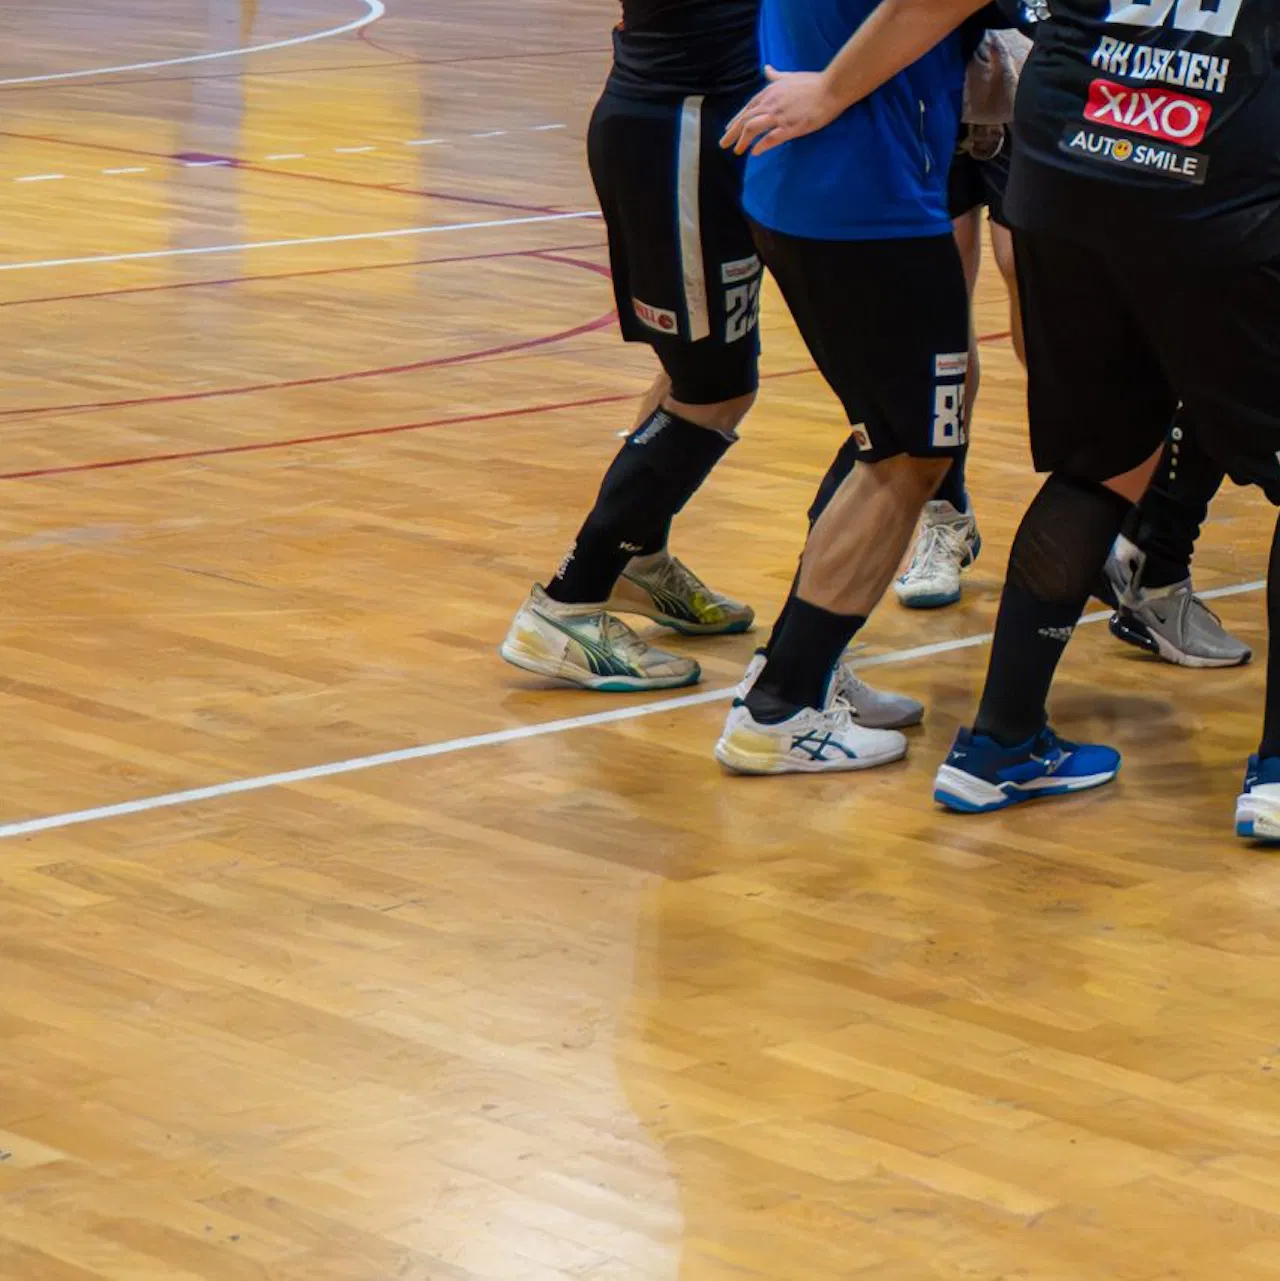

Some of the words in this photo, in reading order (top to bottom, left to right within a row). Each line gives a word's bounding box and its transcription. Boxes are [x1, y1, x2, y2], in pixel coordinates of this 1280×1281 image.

[1092, 36, 1134, 76] RK
[1093, 86, 1200, 138] XIXO
[1133, 145, 1198, 176] SMILE
